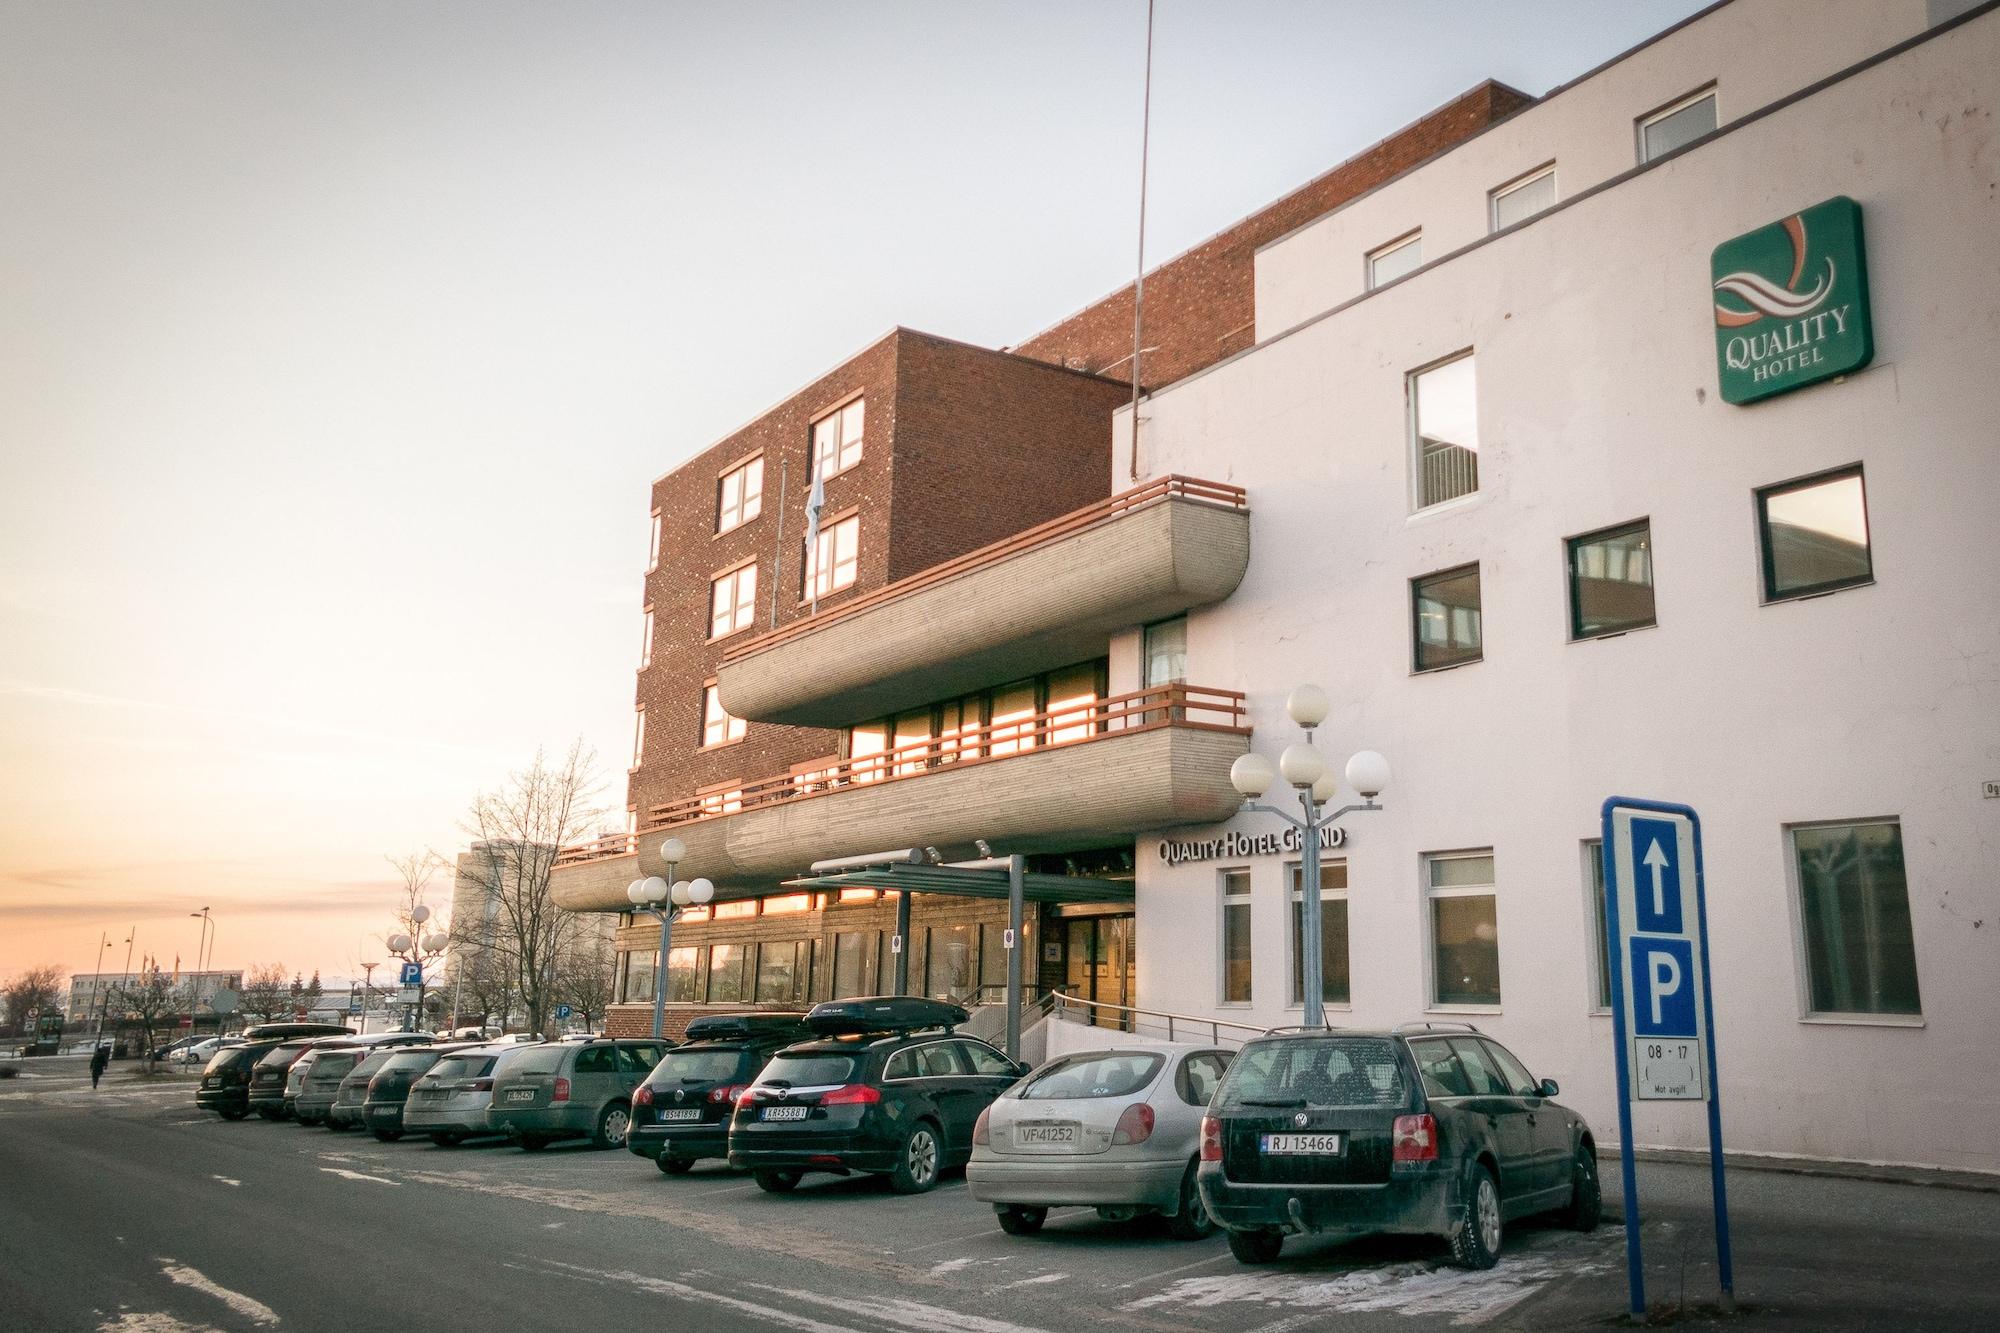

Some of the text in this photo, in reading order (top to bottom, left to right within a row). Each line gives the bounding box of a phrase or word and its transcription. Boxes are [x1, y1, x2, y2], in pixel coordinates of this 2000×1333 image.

[1725, 304, 1849, 370] QUALITY
[1753, 346, 1824, 382] HOTEL
[1159, 825, 1344, 866] QUALITY HOTEL GRND
[405, 965, 419, 981] P
[1647, 950, 1681, 1025] P
[561, 1006, 569, 1018] P
[1647, 1044, 1662, 1059] 08
[1678, 1045, 1688, 1059] 17
[1654, 1084, 1686, 1096] Mot avgift
[1272, 1136, 1334, 1151] RJ 15466
